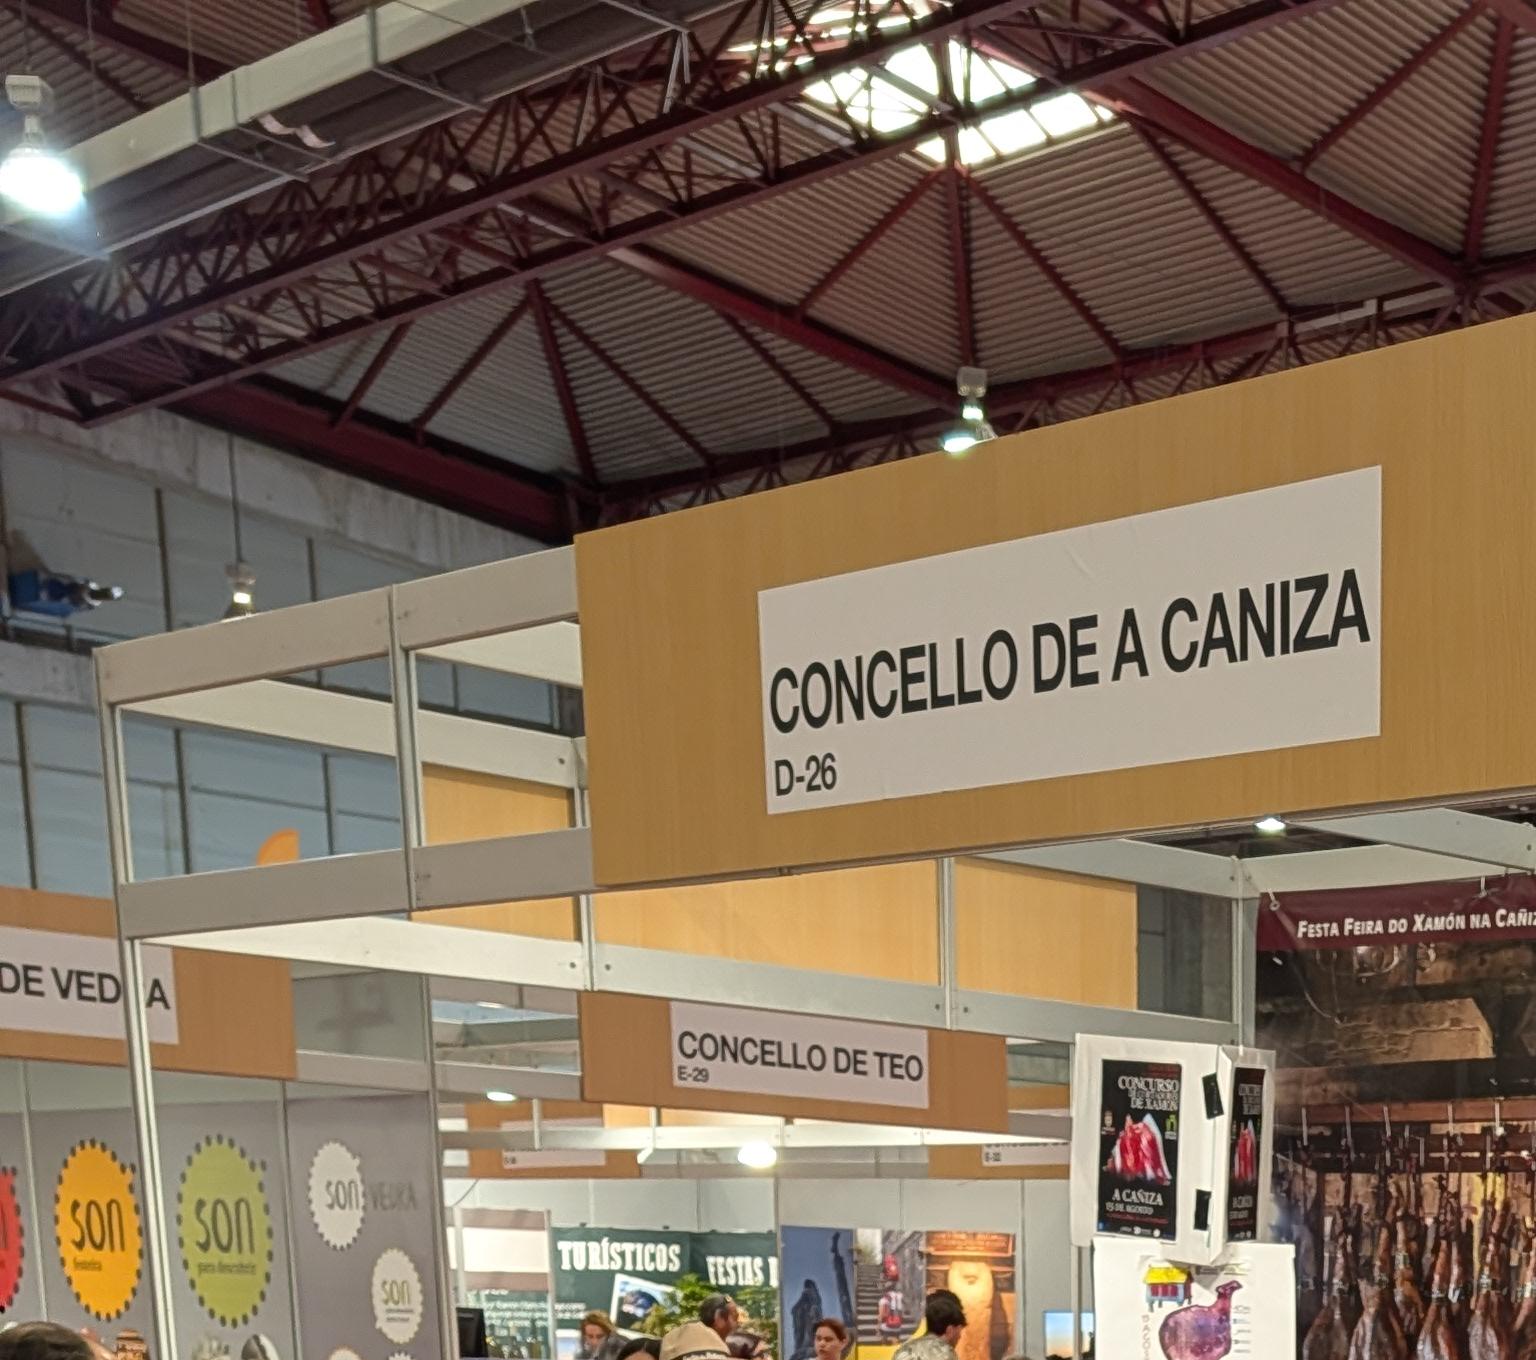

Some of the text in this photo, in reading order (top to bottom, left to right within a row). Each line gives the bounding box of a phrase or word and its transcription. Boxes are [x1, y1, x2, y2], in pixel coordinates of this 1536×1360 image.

[770, 568, 1371, 734] CONCELLO DE A CANIZA
[774, 752, 837, 797] D-26
[0, 962, 170, 1010] DE VEDA
[677, 1030, 924, 1082] CONCELLO DE TEO
[677, 1065, 710, 1083] E-29
[1117, 1075, 1180, 1092] CONCURSO
[1112, 1188, 1121, 1201] A
[557, 1237, 681, 1272] TURÍSTICOS
[705, 1255, 764, 1287] FESTAS
